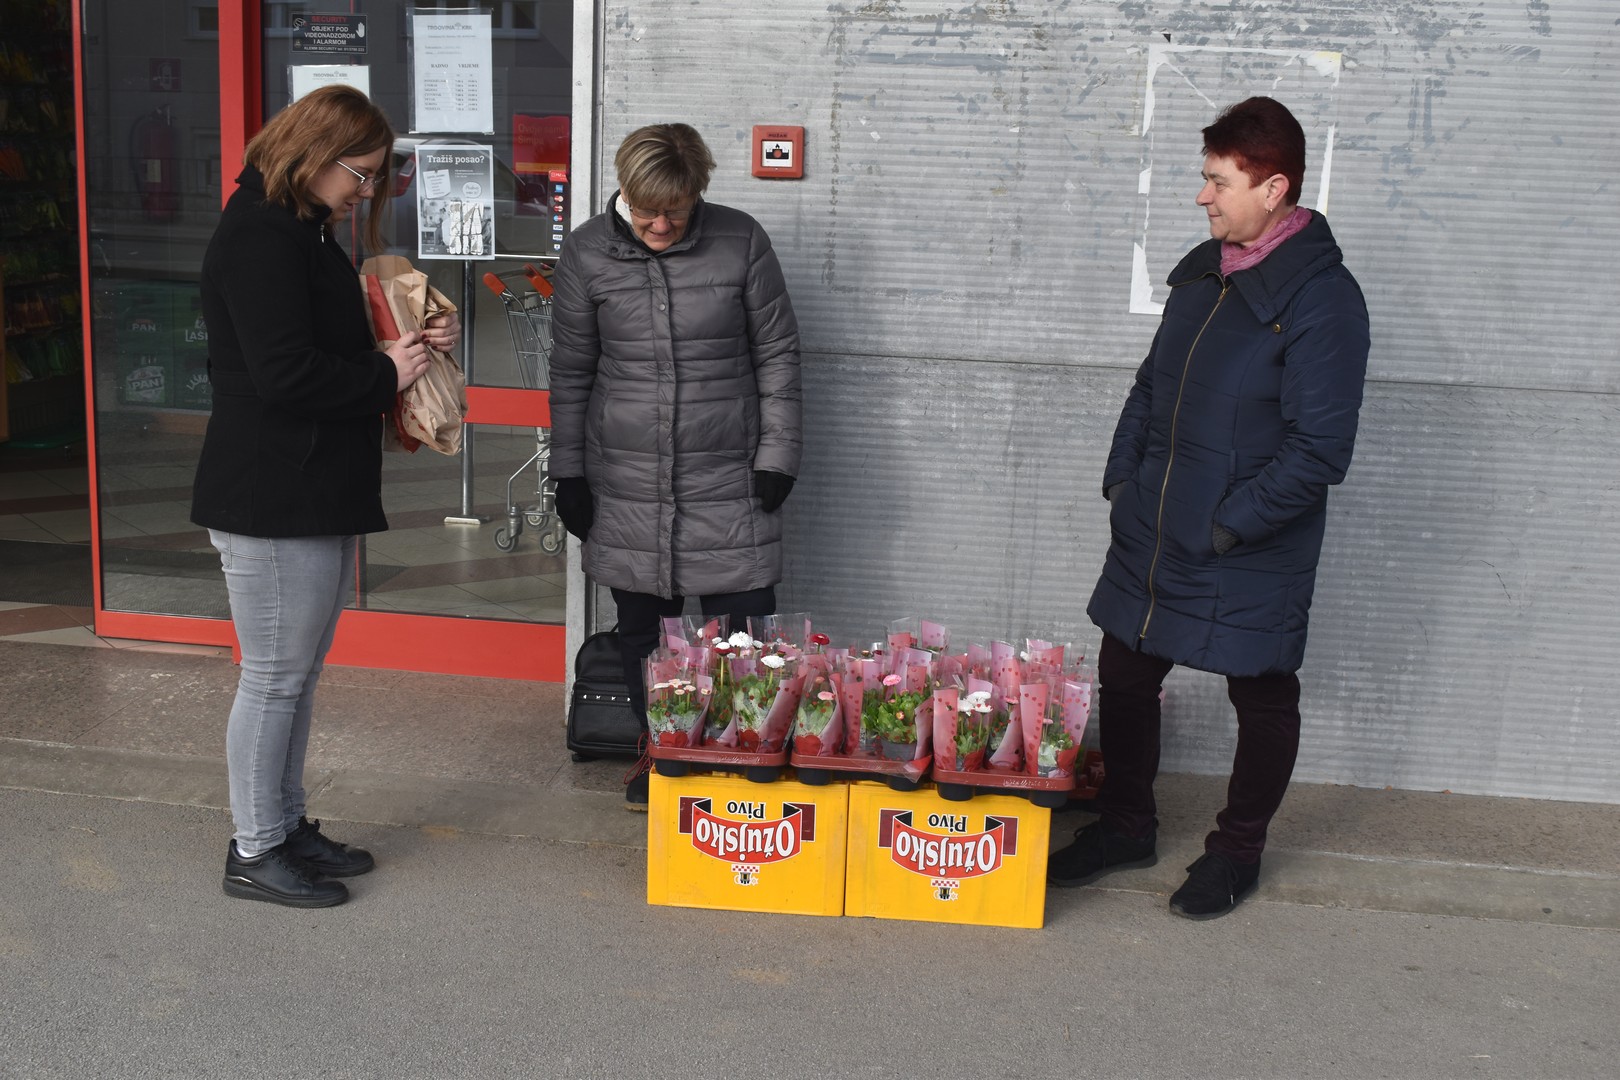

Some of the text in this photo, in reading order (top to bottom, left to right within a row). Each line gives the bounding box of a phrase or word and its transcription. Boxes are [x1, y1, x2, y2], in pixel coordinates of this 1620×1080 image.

[427, 154, 485, 165] Tražiš posao?
[132, 323, 157, 332] PAN
[133, 379, 159, 391] PAN
[727, 801, 765, 819] Pivo
[928, 814, 967, 833] Pivo
[696, 817, 795, 861] Ožujsko
[896, 831, 996, 876] Ožujsko
